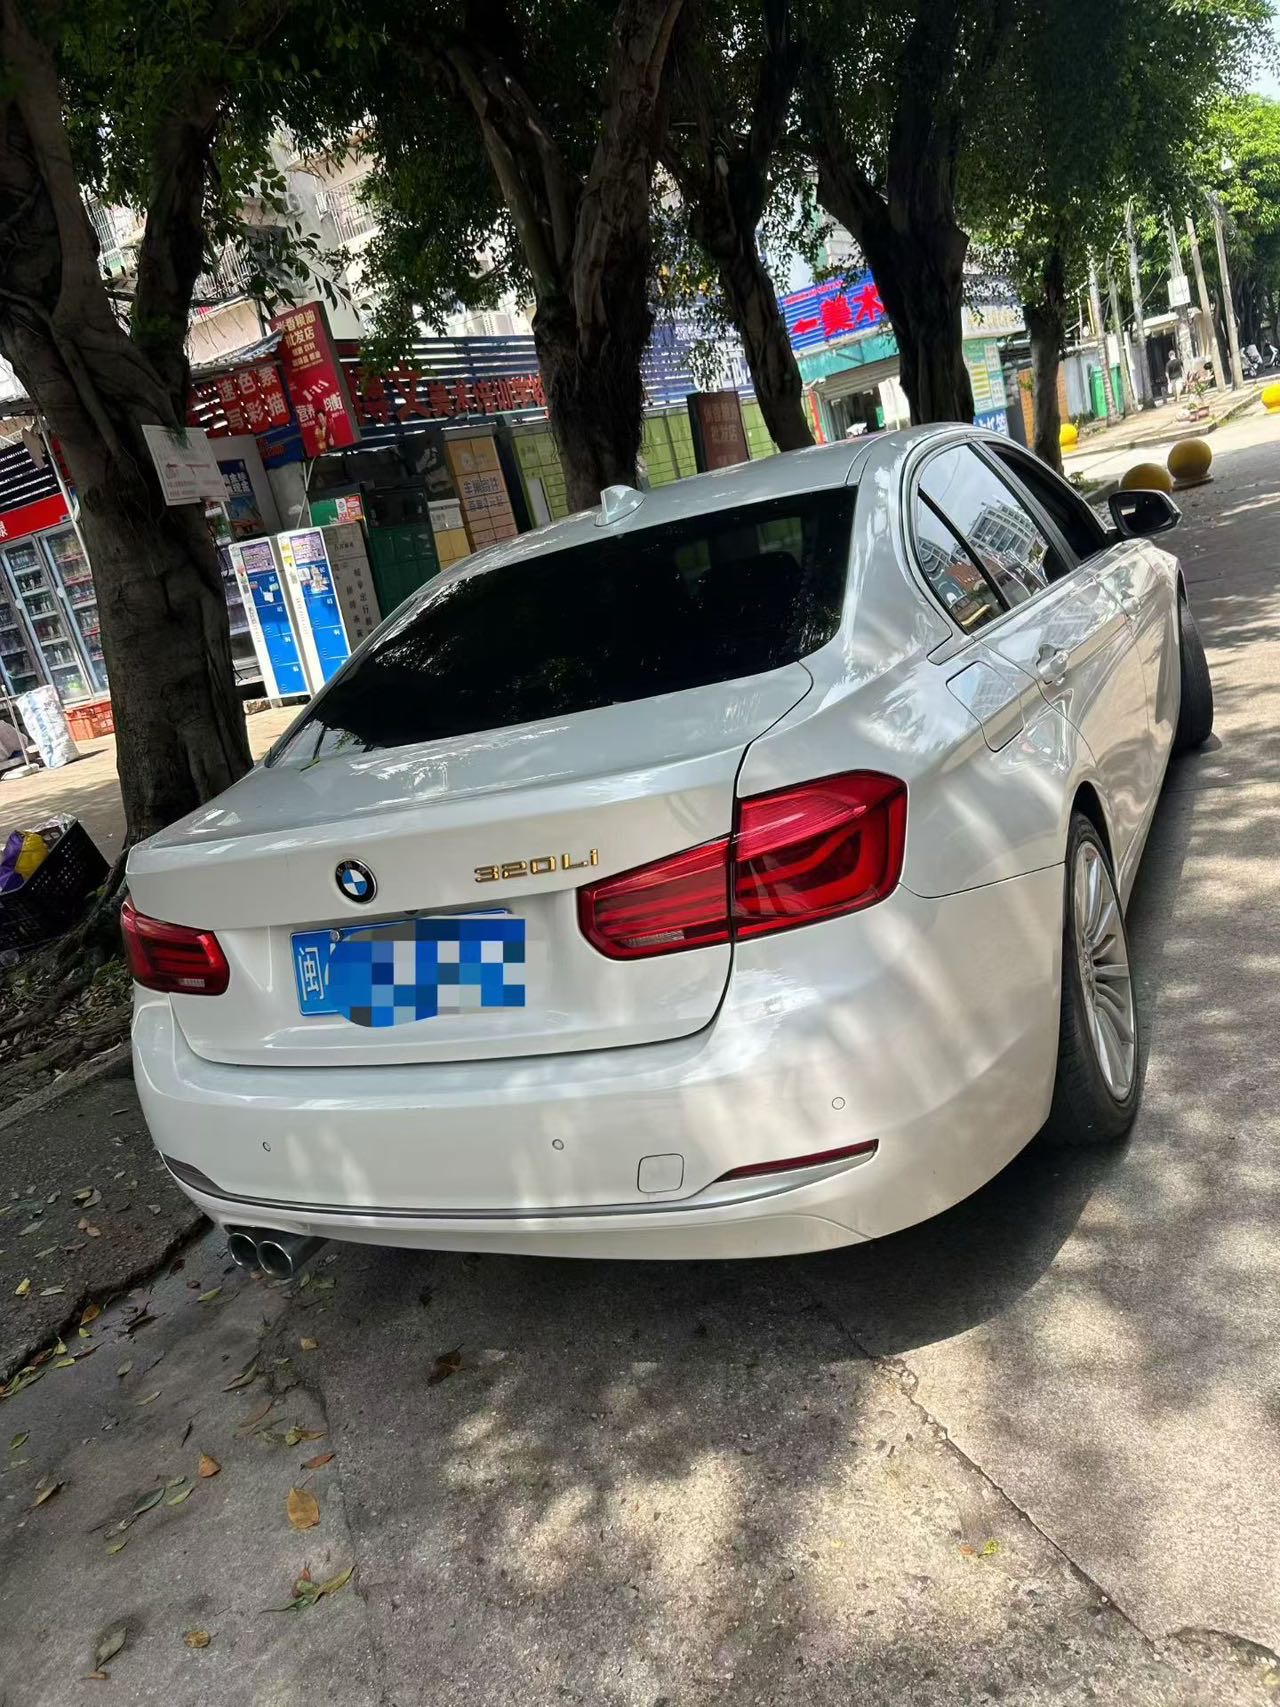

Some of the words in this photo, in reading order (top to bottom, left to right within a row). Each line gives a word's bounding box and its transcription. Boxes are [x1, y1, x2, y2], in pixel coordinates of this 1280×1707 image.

[238, 371, 264, 424] 色彩
[258, 366, 287, 417] 素描
[474, 848, 599, 884] 320Li
